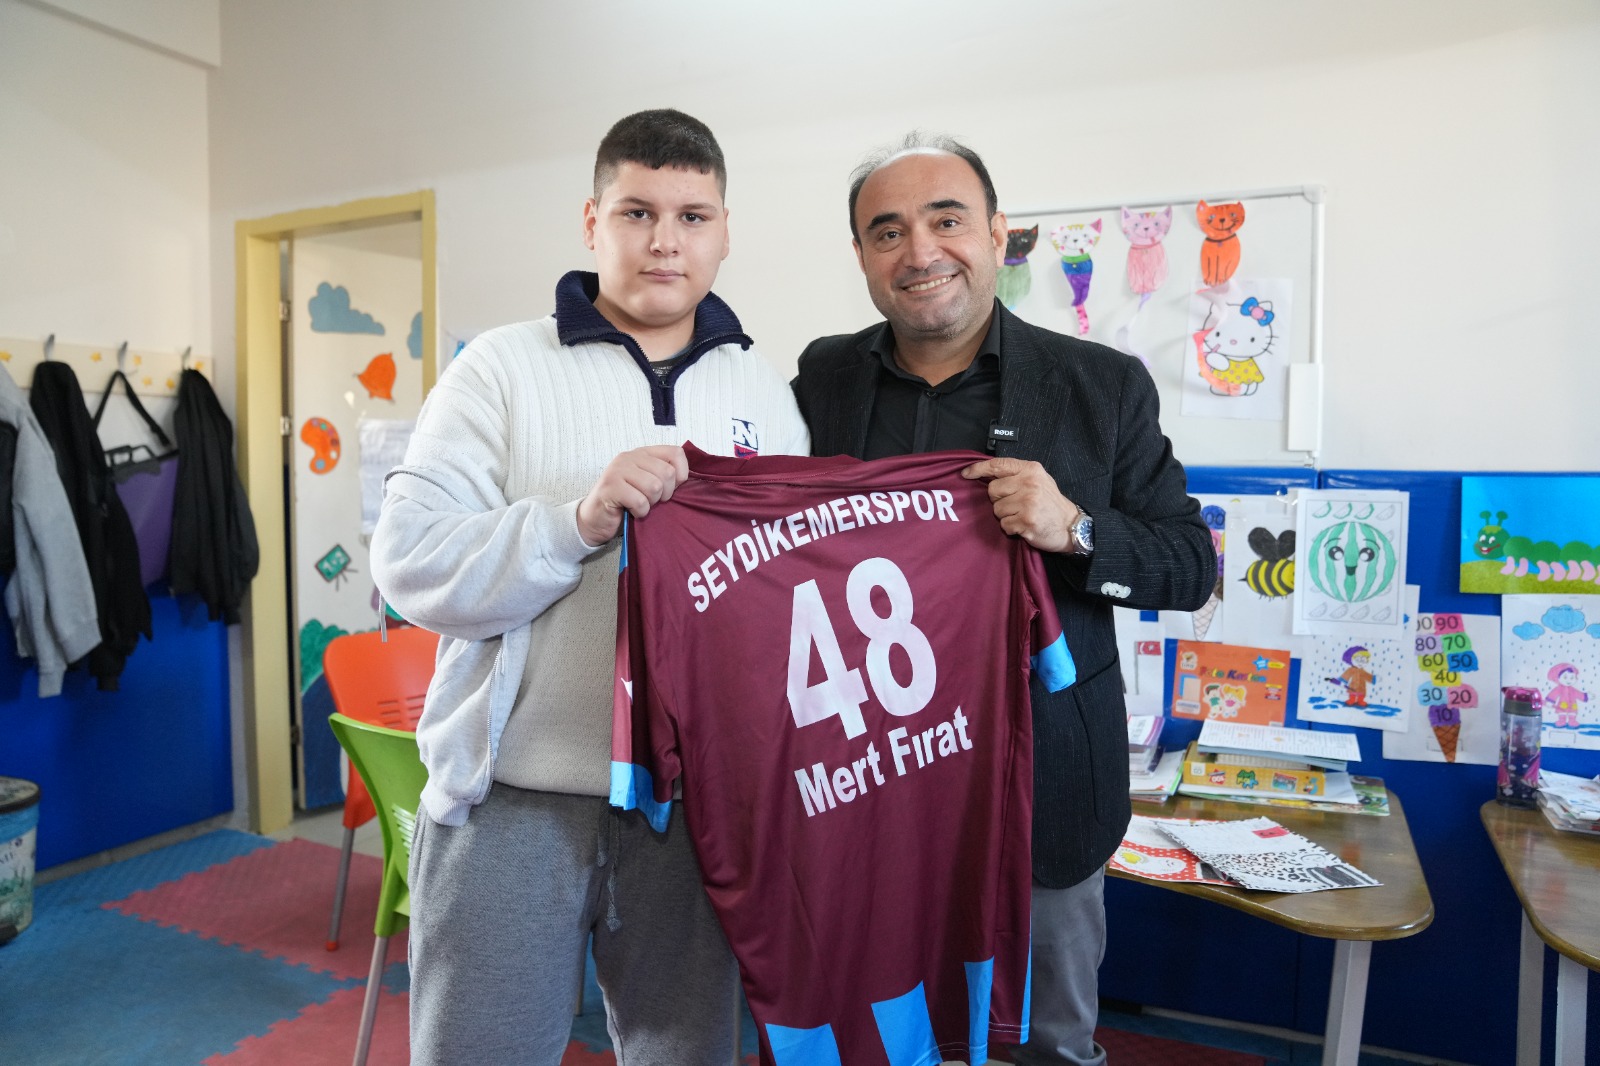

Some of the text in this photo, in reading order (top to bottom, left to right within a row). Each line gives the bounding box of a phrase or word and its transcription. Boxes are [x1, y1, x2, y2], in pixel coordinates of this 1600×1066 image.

[687, 489, 960, 613] SEYDİKEMERSPOR
[1435, 616, 1459, 631] 90
[786, 556, 937, 741] 48
[1415, 634, 1466, 651] 80 70
[1422, 652, 1473, 669] 60 50
[1434, 669, 1457, 683] 40
[1421, 687, 1472, 705] 30 20
[1434, 707, 1453, 722] 10
[794, 705, 973, 818] Mert Fırat
